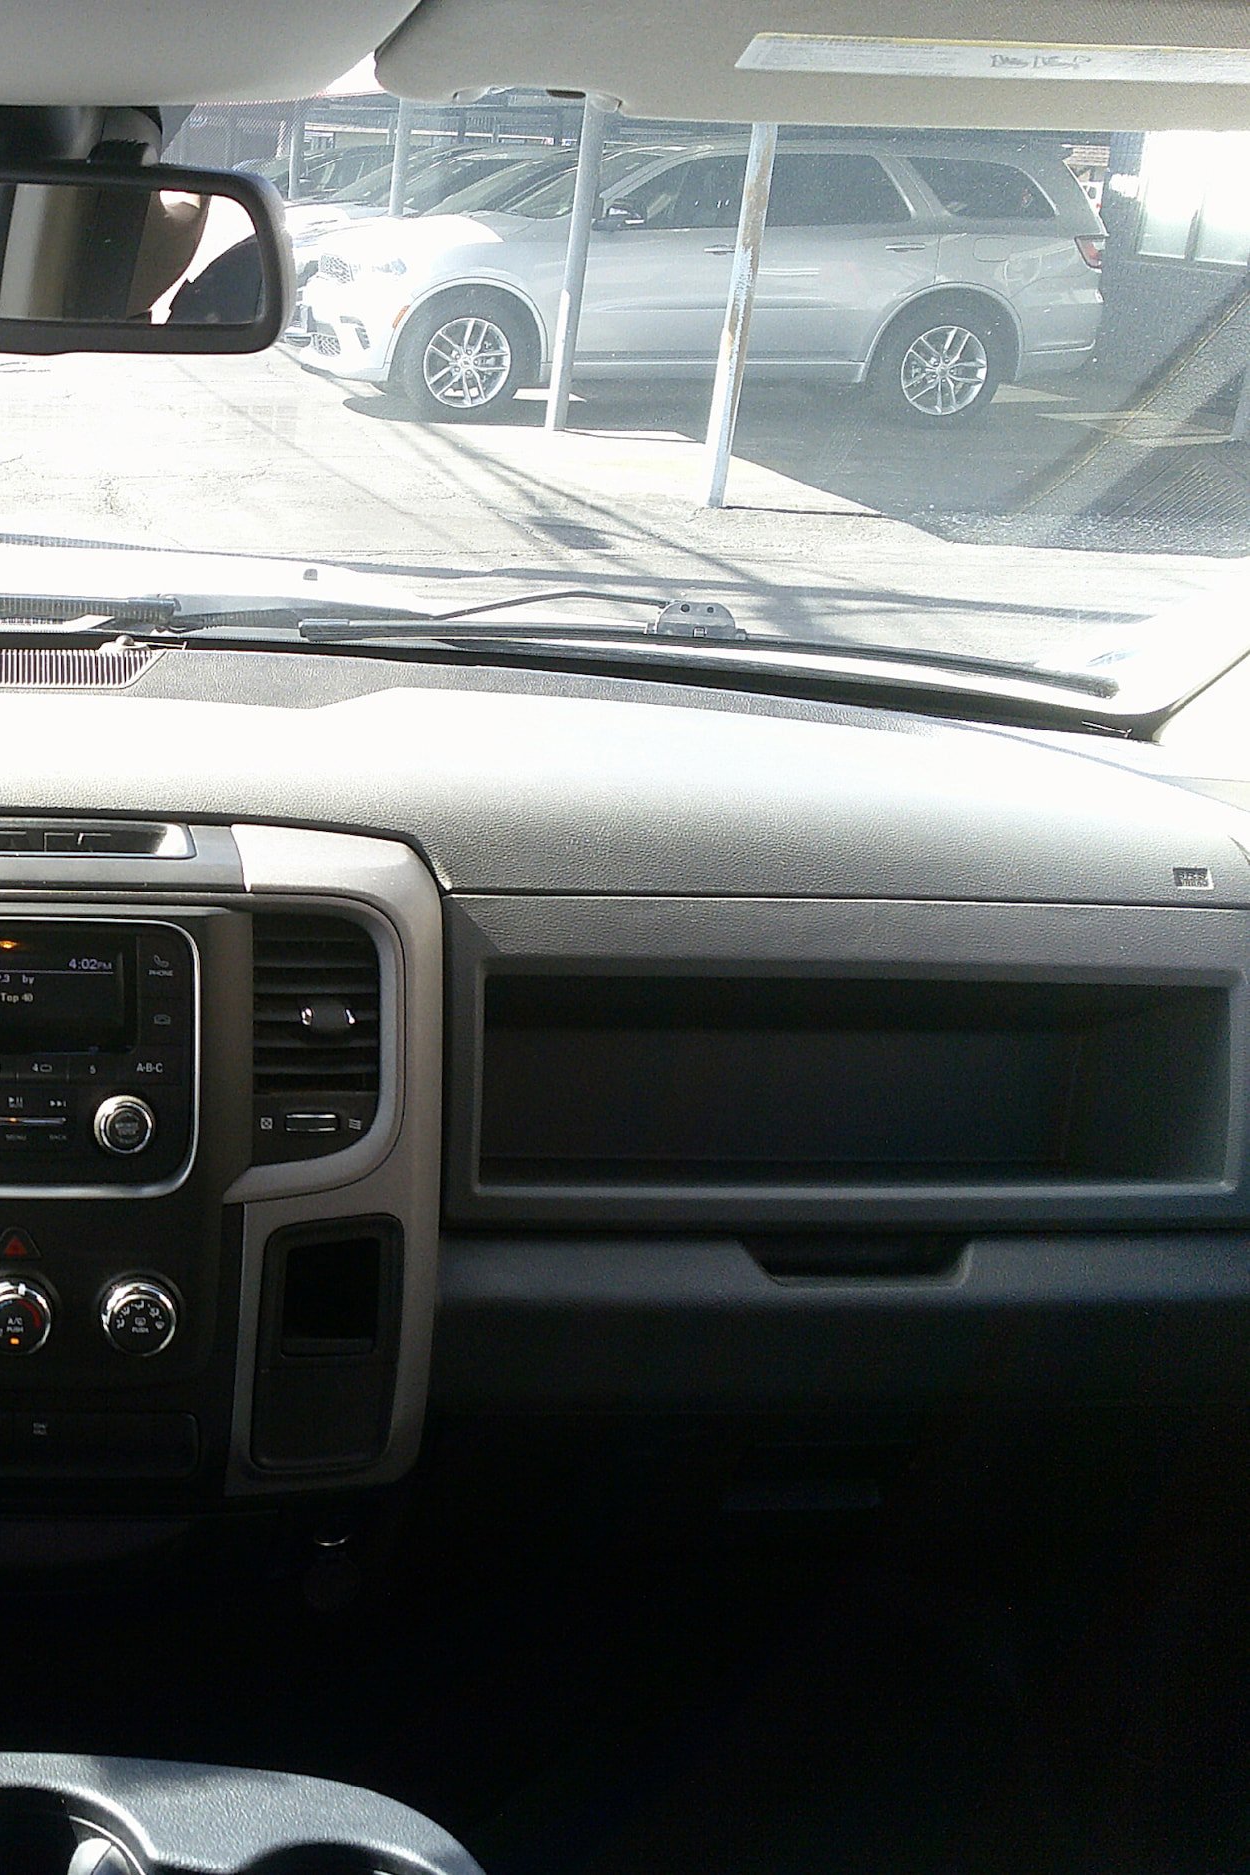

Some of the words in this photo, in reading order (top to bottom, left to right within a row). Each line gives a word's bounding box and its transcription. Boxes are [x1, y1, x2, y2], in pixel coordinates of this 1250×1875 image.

[0, 992, 19, 1003] Top
[31, 1064, 38, 1073] 4
[7, 1317, 22, 1325] A/C
